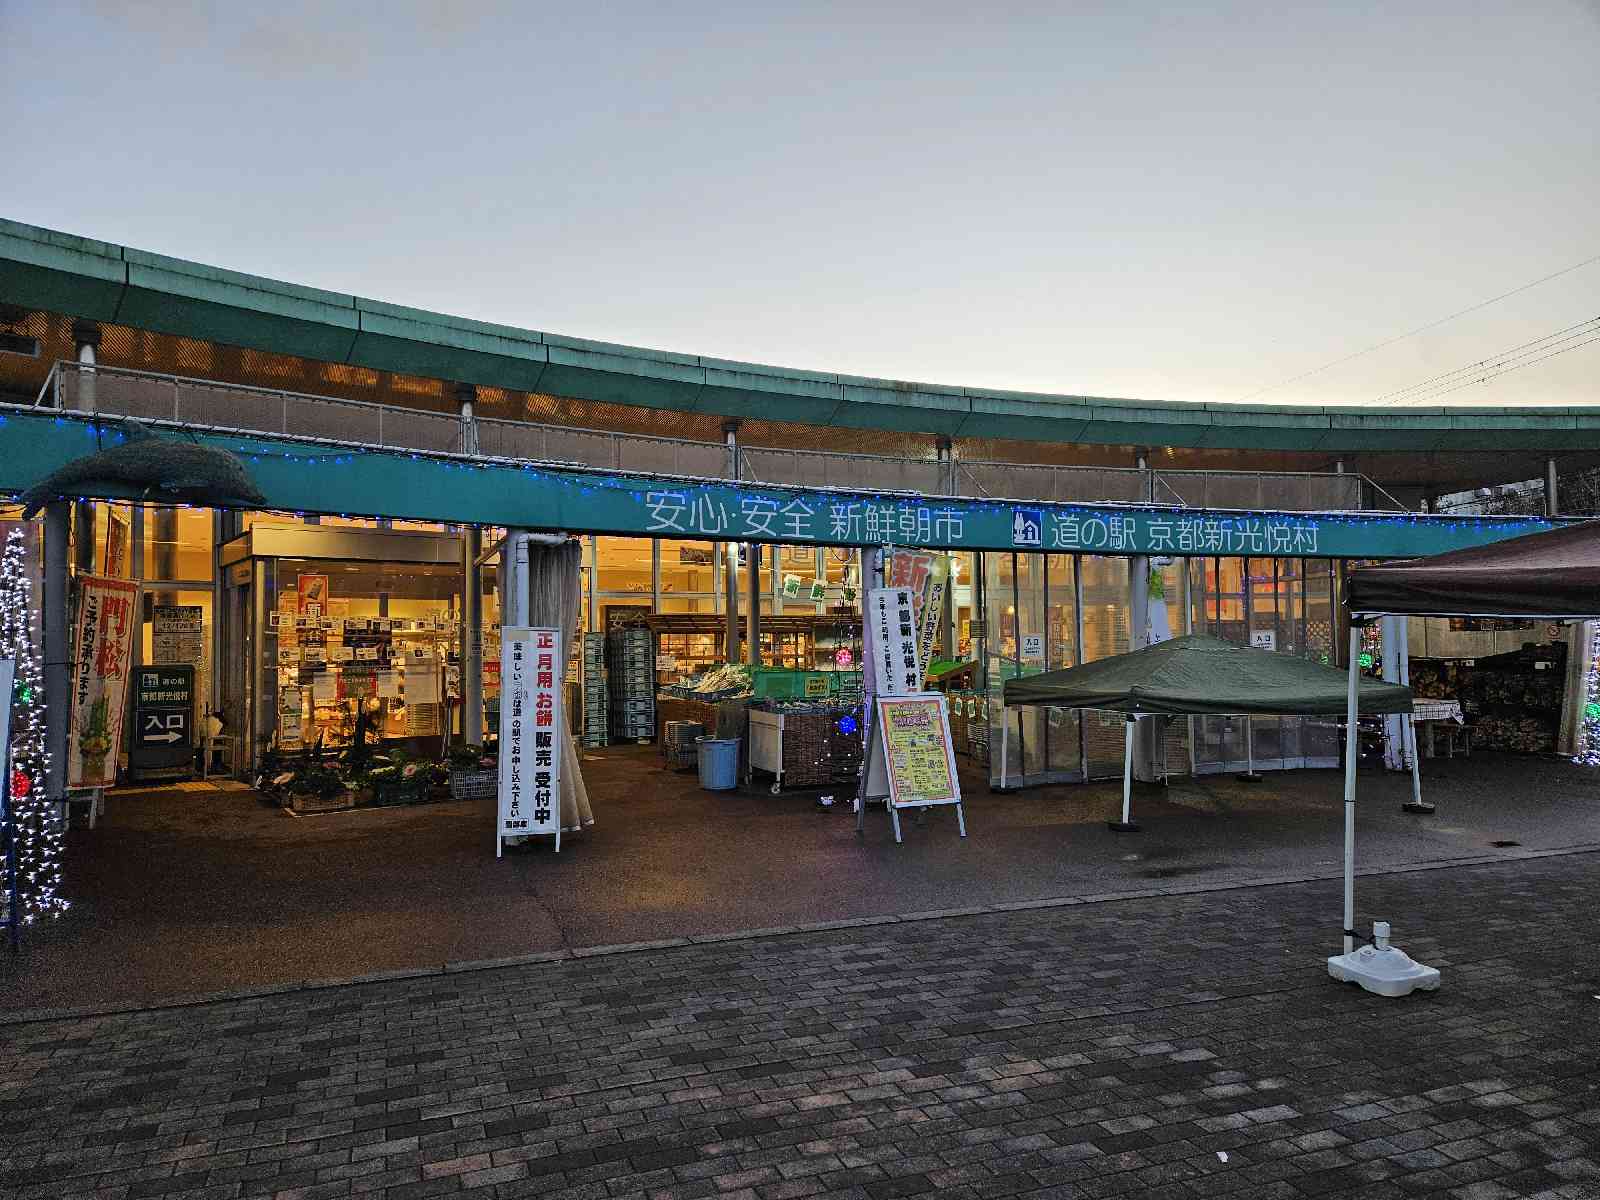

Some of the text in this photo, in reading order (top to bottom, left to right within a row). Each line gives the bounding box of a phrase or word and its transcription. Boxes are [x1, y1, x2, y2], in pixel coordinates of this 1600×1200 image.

[646, 491, 964, 543] 安心・安全 新鮮朝市
[1050, 513, 1318, 553] 道の駅 京都新光悦村
[144, 714, 184, 730] 入口
[511, 642, 523, 818] 美味しいは道の駅でお申し込み下さい
[535, 632, 553, 825] 正月用お餅販売受付中
